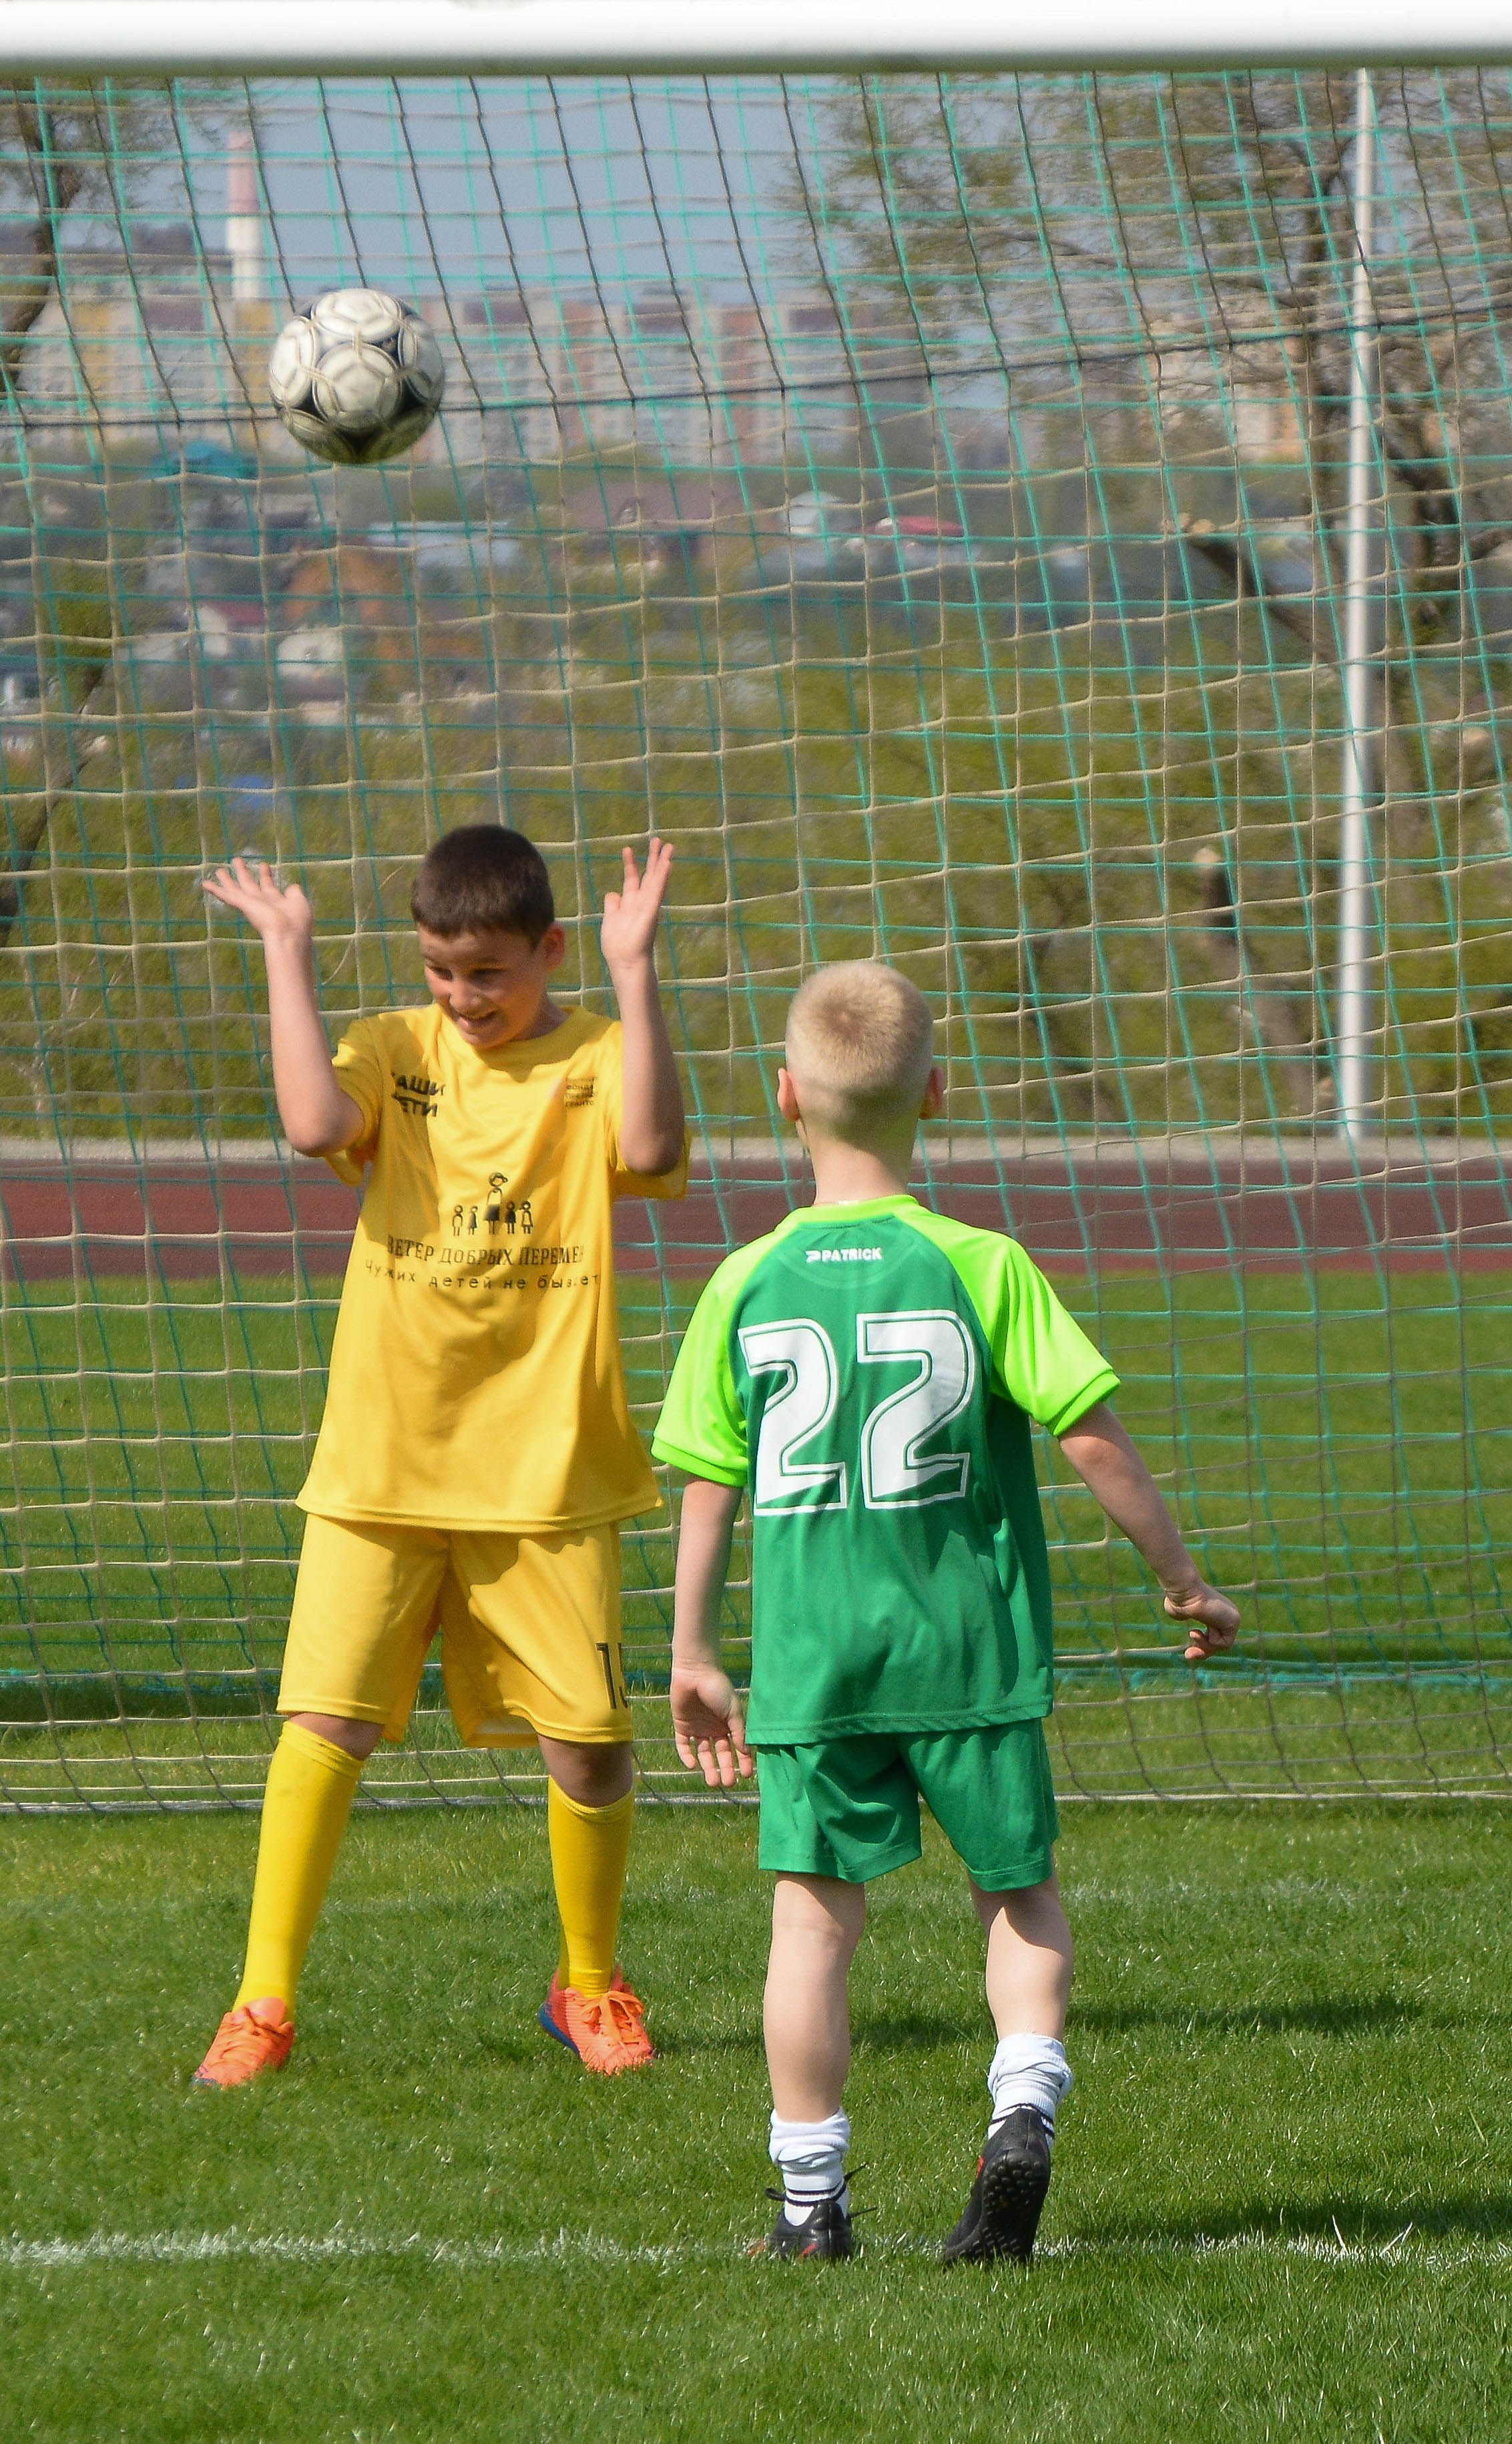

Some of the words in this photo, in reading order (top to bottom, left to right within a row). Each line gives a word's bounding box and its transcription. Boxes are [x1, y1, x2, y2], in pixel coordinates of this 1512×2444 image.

[391, 1072, 445, 1096] АШИ
[438, 1247, 513, 1265] ДОБРЫХ
[822, 1247, 882, 1262] PATRICK
[429, 1276, 491, 1289] детей
[503, 1278, 526, 1289] не
[537, 1274, 598, 1289] бывет
[738, 1309, 976, 1516] 22
